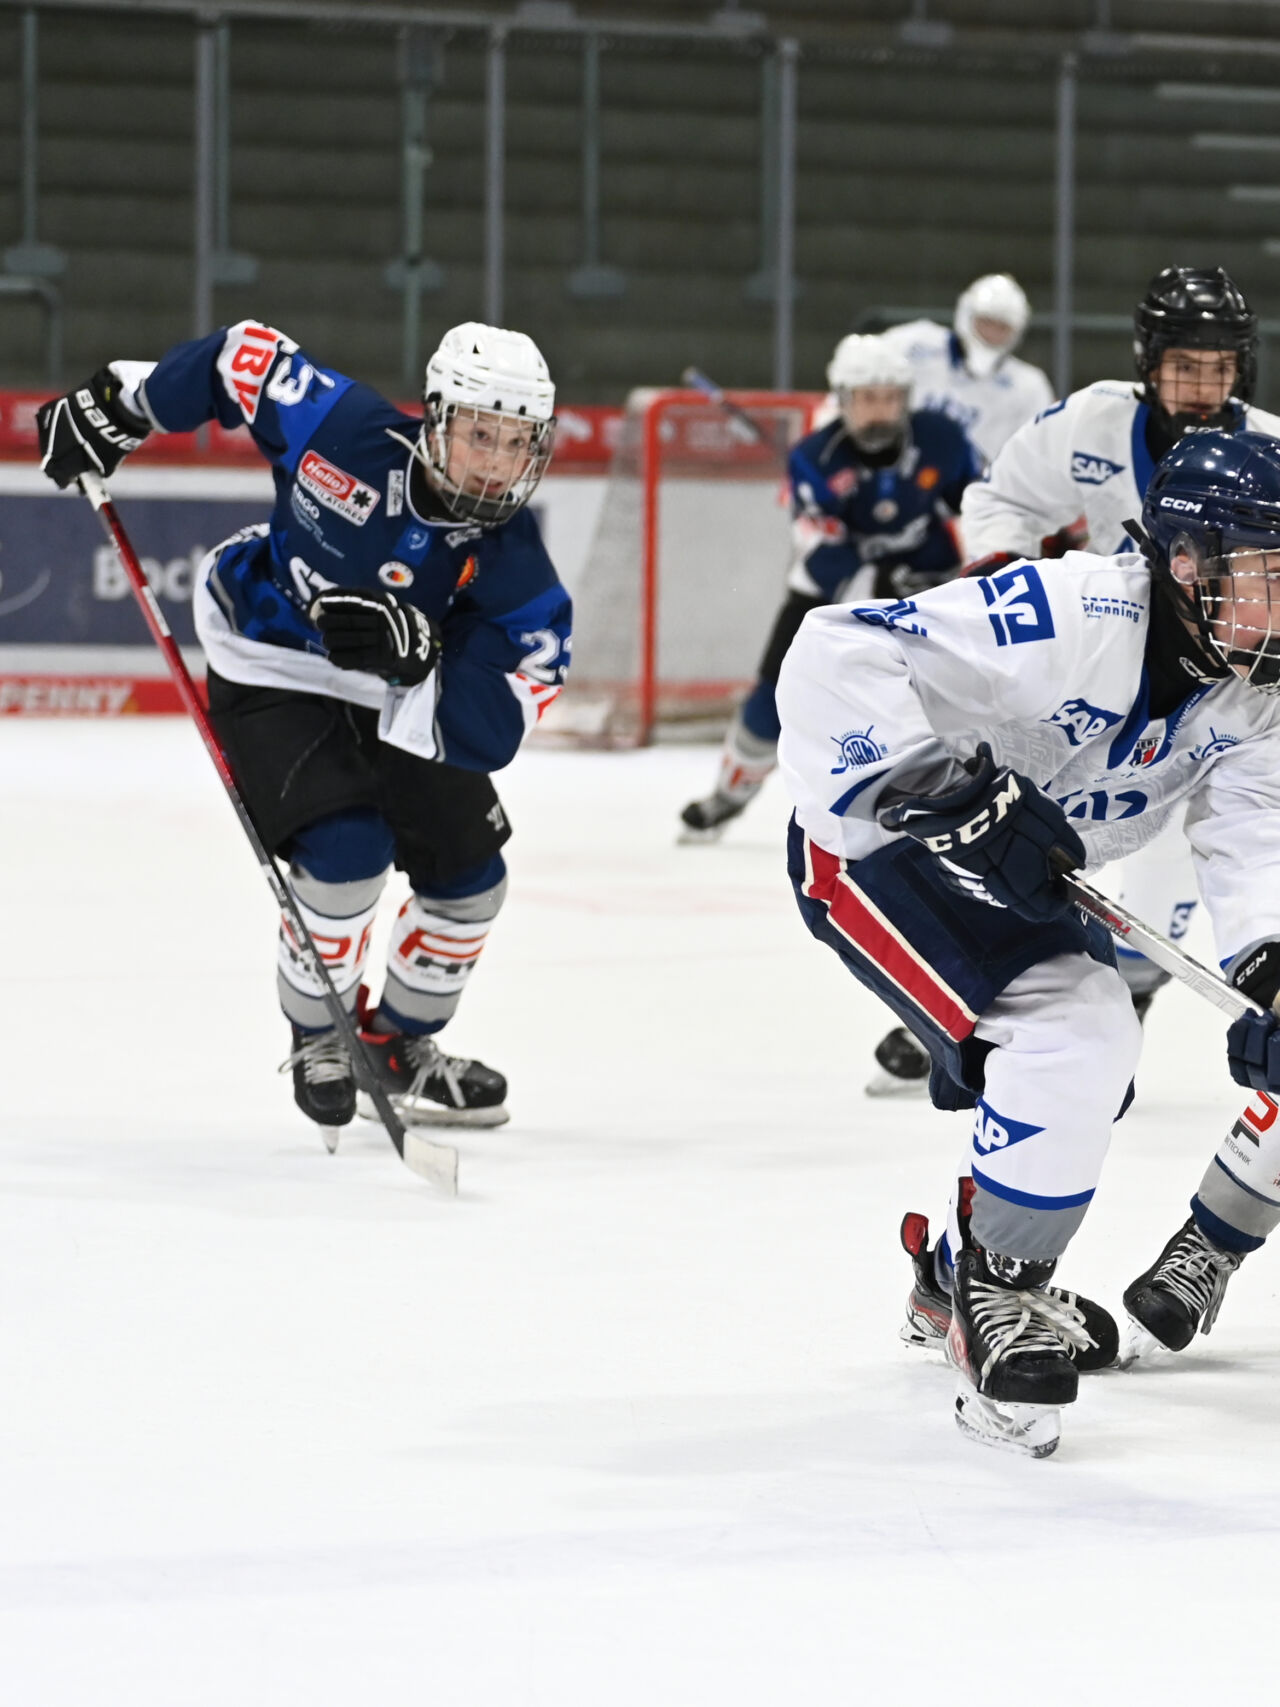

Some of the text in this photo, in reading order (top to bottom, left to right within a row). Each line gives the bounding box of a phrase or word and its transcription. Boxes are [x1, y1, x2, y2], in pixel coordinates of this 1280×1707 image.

[1072, 456, 1114, 482] SAP
[1160, 497, 1203, 513] CCM
[1083, 602, 1139, 623] pfenning
[1052, 702, 1107, 743] SAP
[924, 774, 1021, 854] CCM
[1236, 951, 1267, 986] CCM
[972, 1105, 1009, 1151] AP
